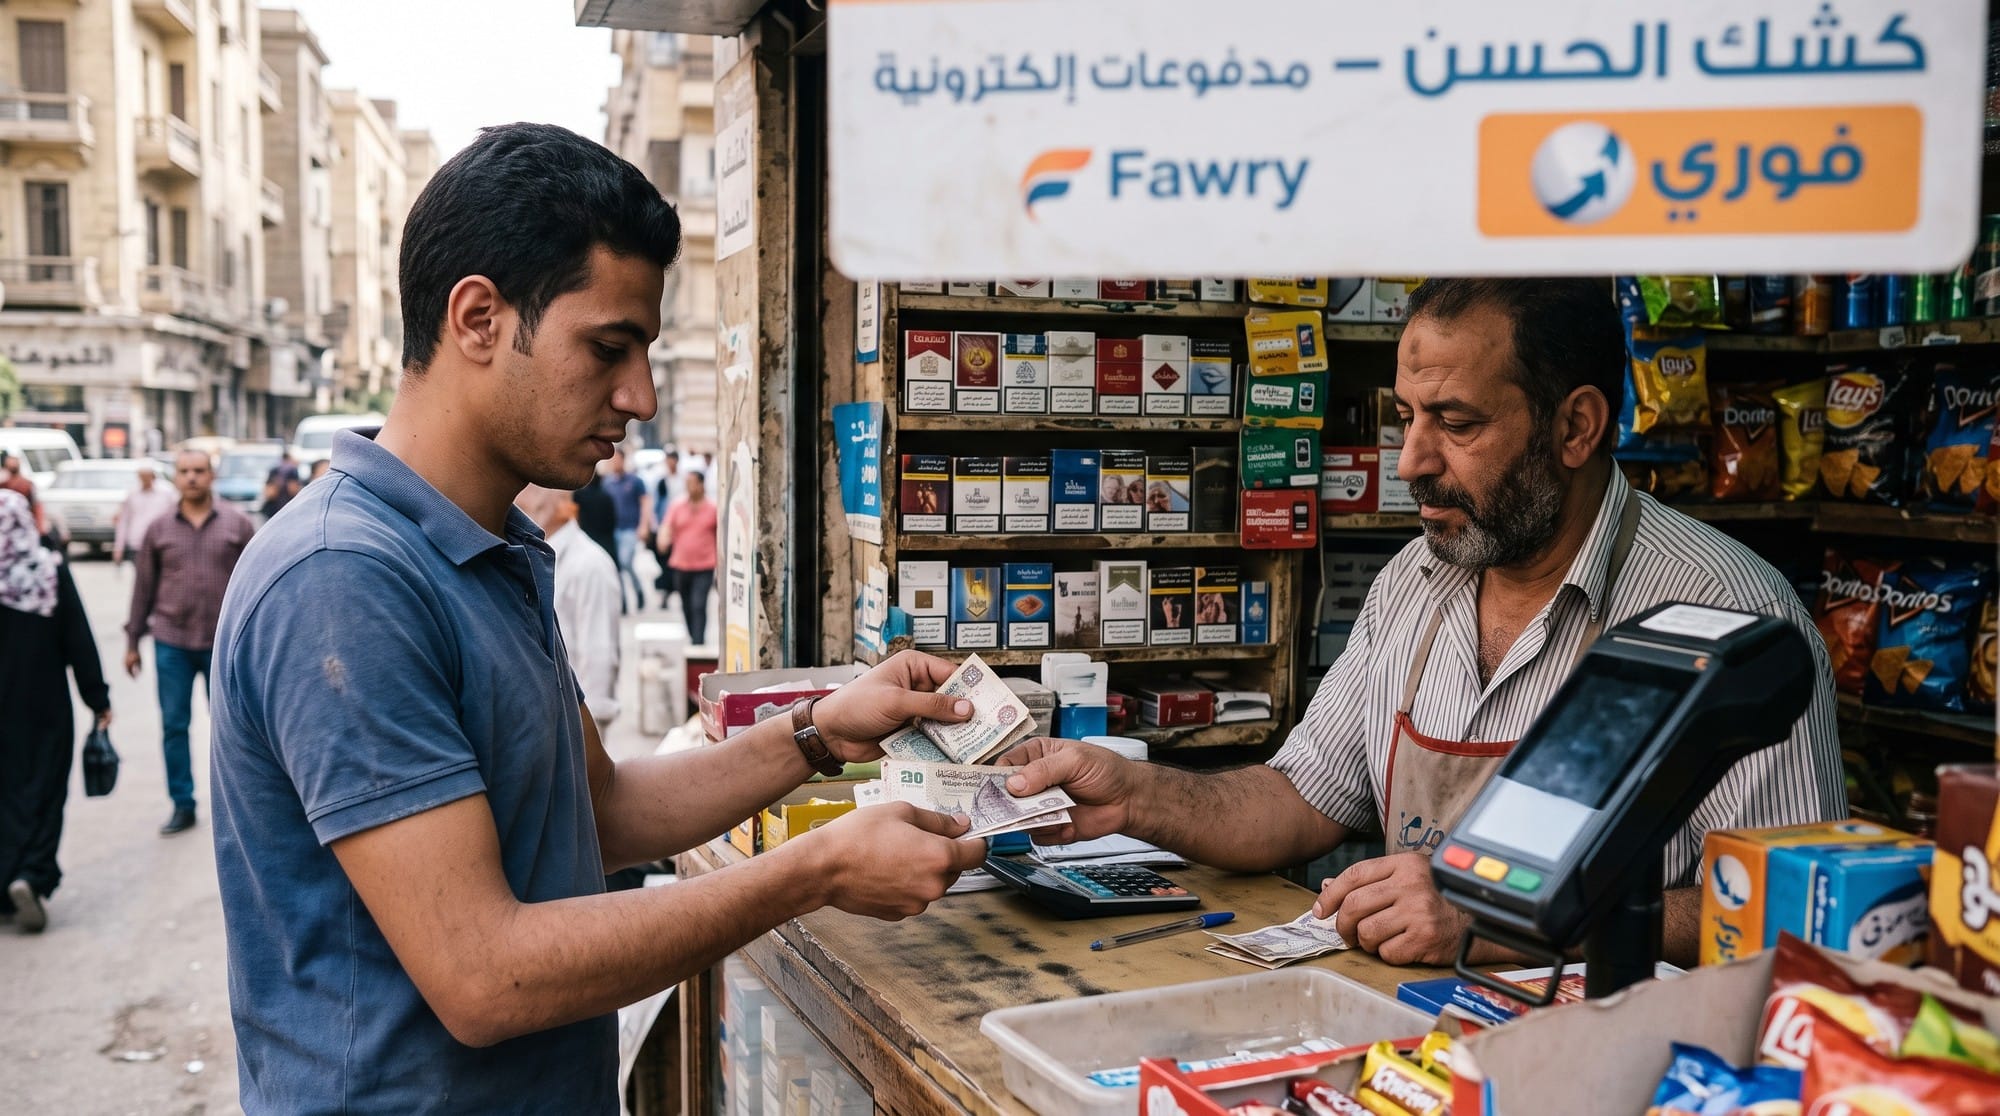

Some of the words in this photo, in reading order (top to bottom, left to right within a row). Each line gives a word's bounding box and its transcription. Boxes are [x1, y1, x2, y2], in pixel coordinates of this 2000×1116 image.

[1090, 45, 1311, 98] مدفوعات
[1404, 20, 1668, 98] الحسن
[1694, 3, 1927, 77] كشك
[873, 51, 1078, 105] إلكترونية
[1108, 149, 1311, 211] Fawry
[1650, 123, 1866, 223] فوري
